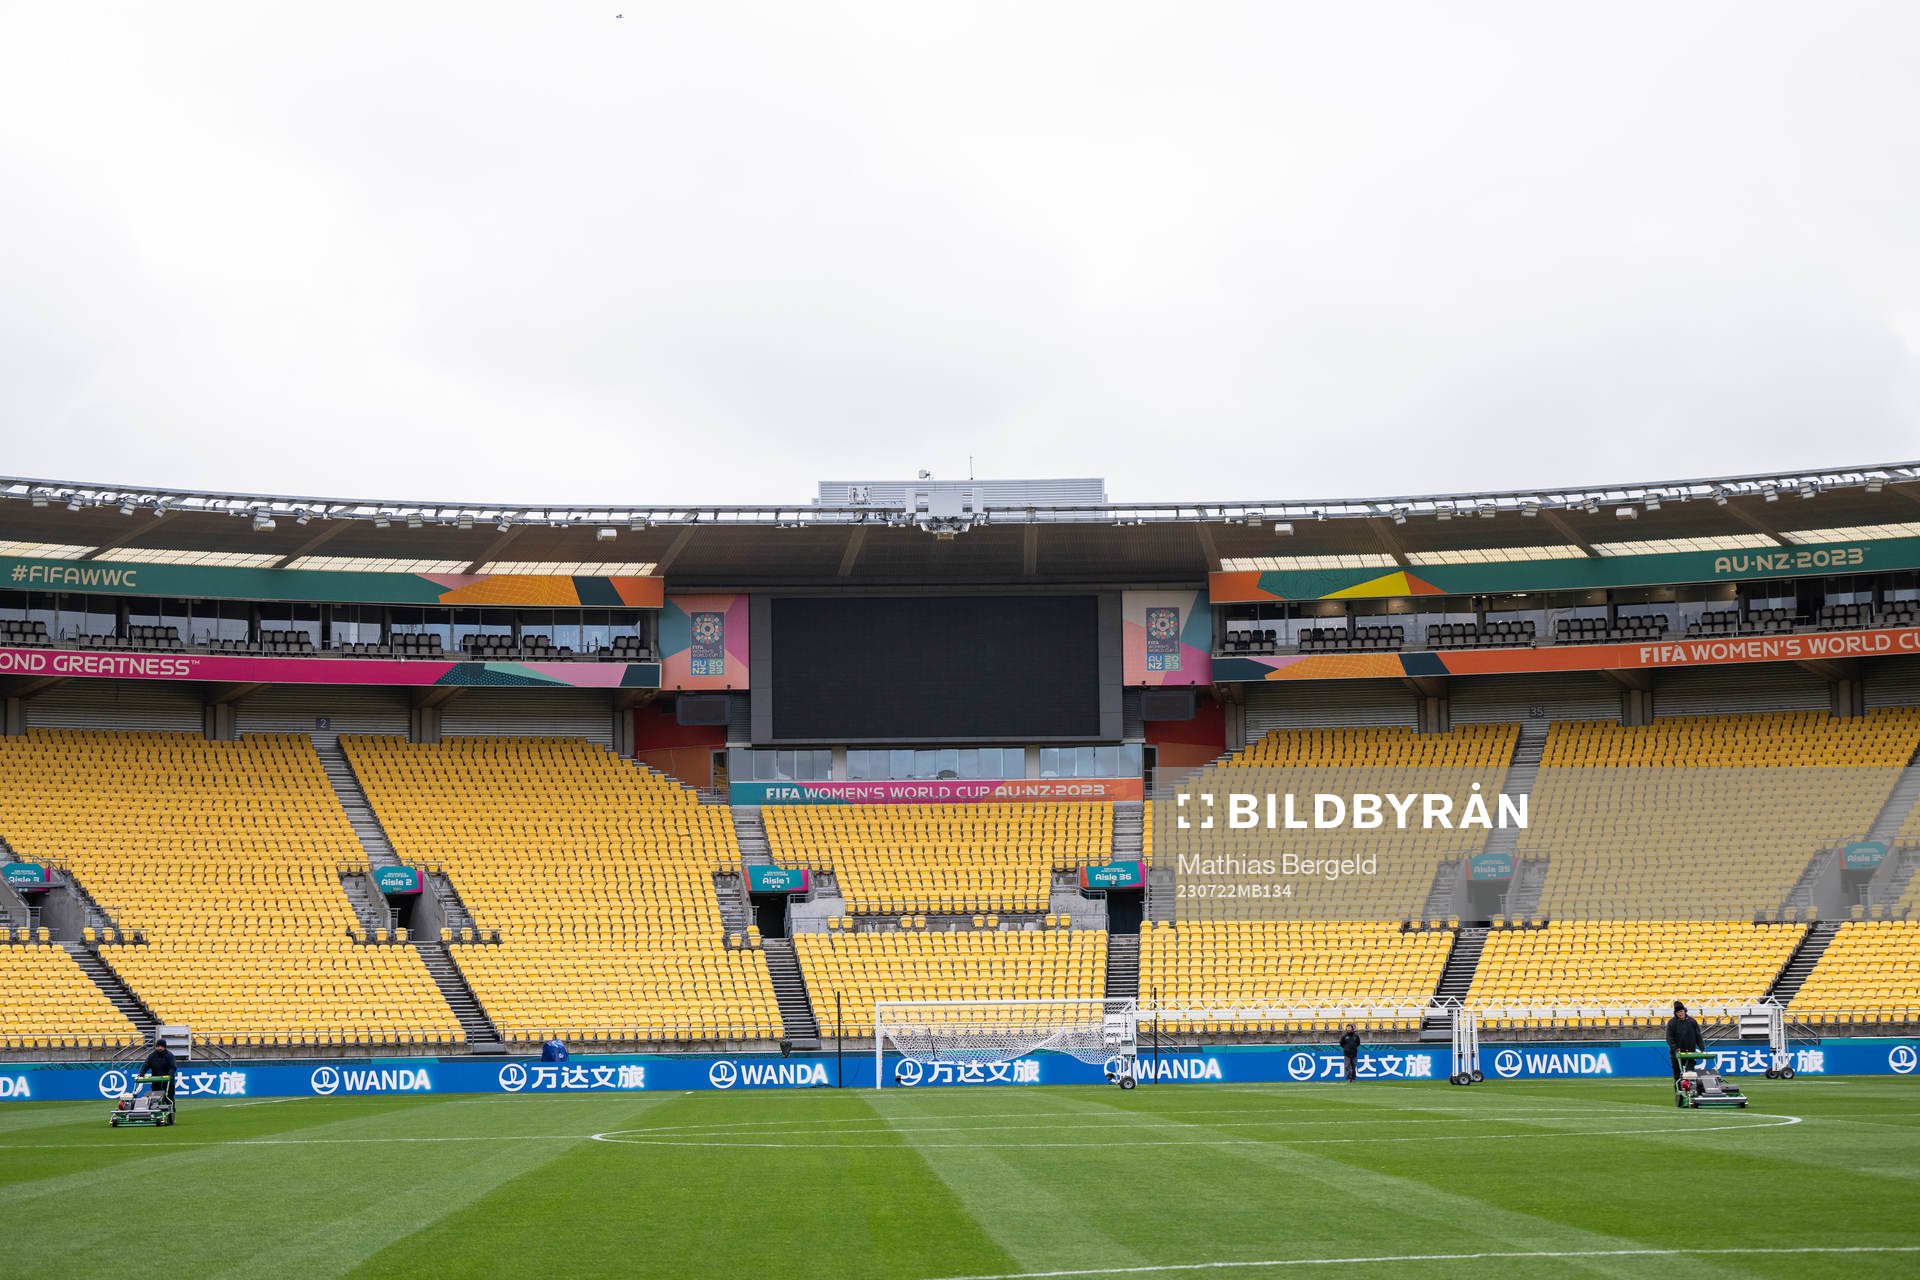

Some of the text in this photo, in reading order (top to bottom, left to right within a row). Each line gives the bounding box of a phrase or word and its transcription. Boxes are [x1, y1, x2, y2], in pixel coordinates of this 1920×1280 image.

[11, 564, 137, 587] #FIFAWWC
[1640, 645, 1687, 664] FIFA
[1690, 639, 1801, 661] WOMEN'S
[1808, 634, 1891, 655] WORLD
[766, 787, 800, 799] FIFA
[804, 786, 885, 799] WOMEN'S
[890, 786, 950, 798] WORLD
[956, 785, 990, 798] CUP
[741, 1063, 829, 1085] WANDA
[928, 1058, 1040, 1083] 万达文旅
[1136, 1057, 1222, 1080] WANDA
[1525, 1052, 1612, 1075] WANDA
[344, 1068, 431, 1092] WANDA
[531, 1064, 645, 1089] 万达文旅
